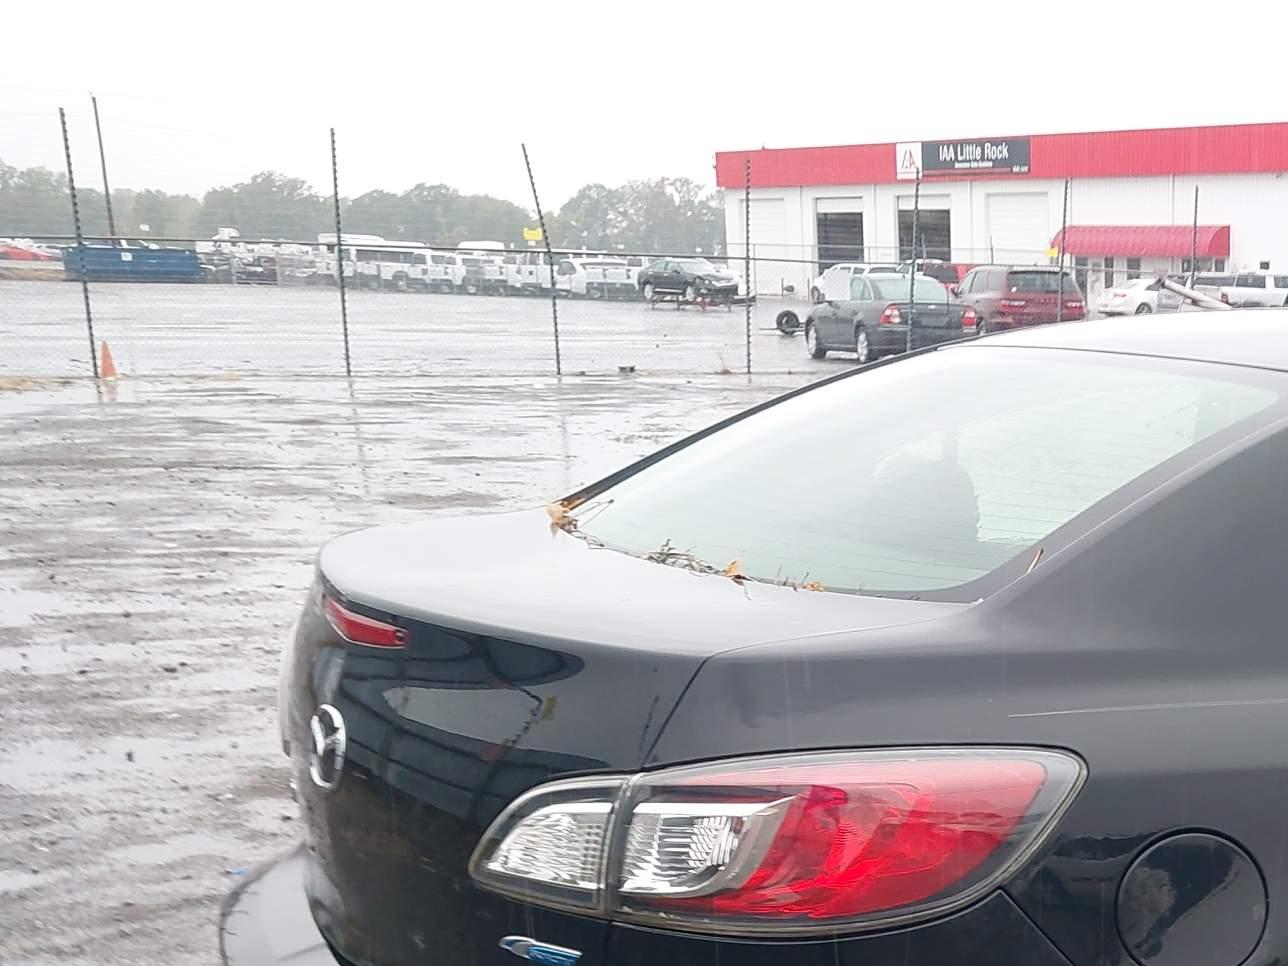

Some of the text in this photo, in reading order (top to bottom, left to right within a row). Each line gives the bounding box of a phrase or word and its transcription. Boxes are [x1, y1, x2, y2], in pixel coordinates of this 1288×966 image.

[939, 142, 1009, 161] IAA Little Rock
